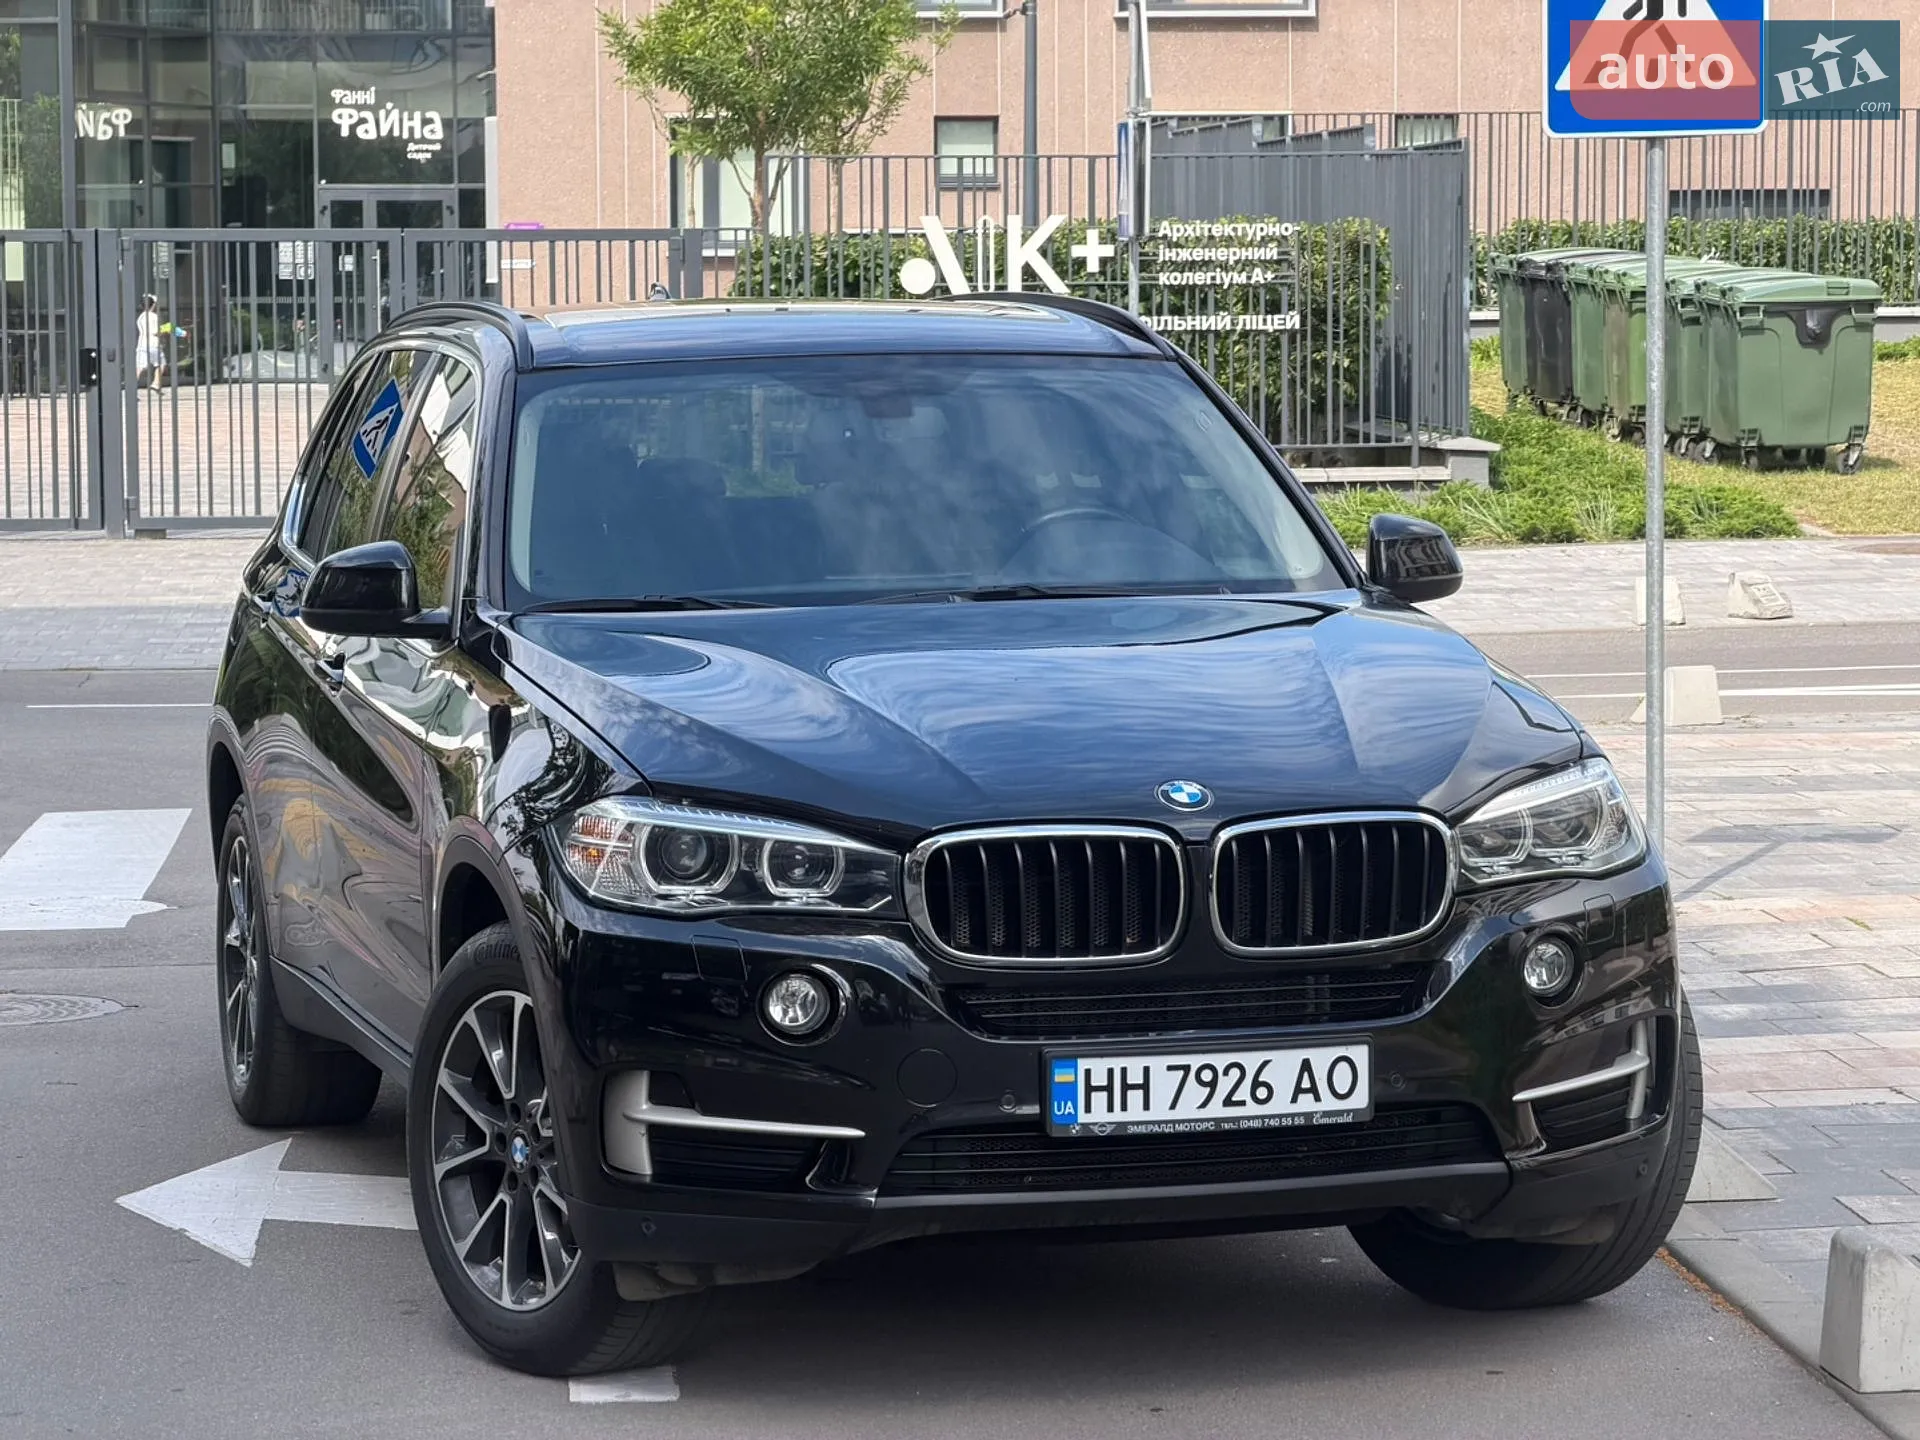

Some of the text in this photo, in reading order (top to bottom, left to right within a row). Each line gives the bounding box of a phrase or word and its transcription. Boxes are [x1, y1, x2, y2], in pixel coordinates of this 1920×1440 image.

[1158, 221, 1301, 241] Архітектурно-
[1158, 244, 1278, 264] інженерний
[1158, 268, 1247, 289] колегіум
[1235, 311, 1300, 333] ЛІЦЕЙ
[1166, 1059, 1275, 1111] 7926
[1054, 1101, 1076, 1116] UA
[1313, 1111, 1354, 1125] Emerald
[1175, 1121, 1216, 1132] МОТОРС
[1264, 1117, 1280, 1127] 740
[1281, 1117, 1292, 1126] 55
[1293, 1116, 1305, 1125] 55
